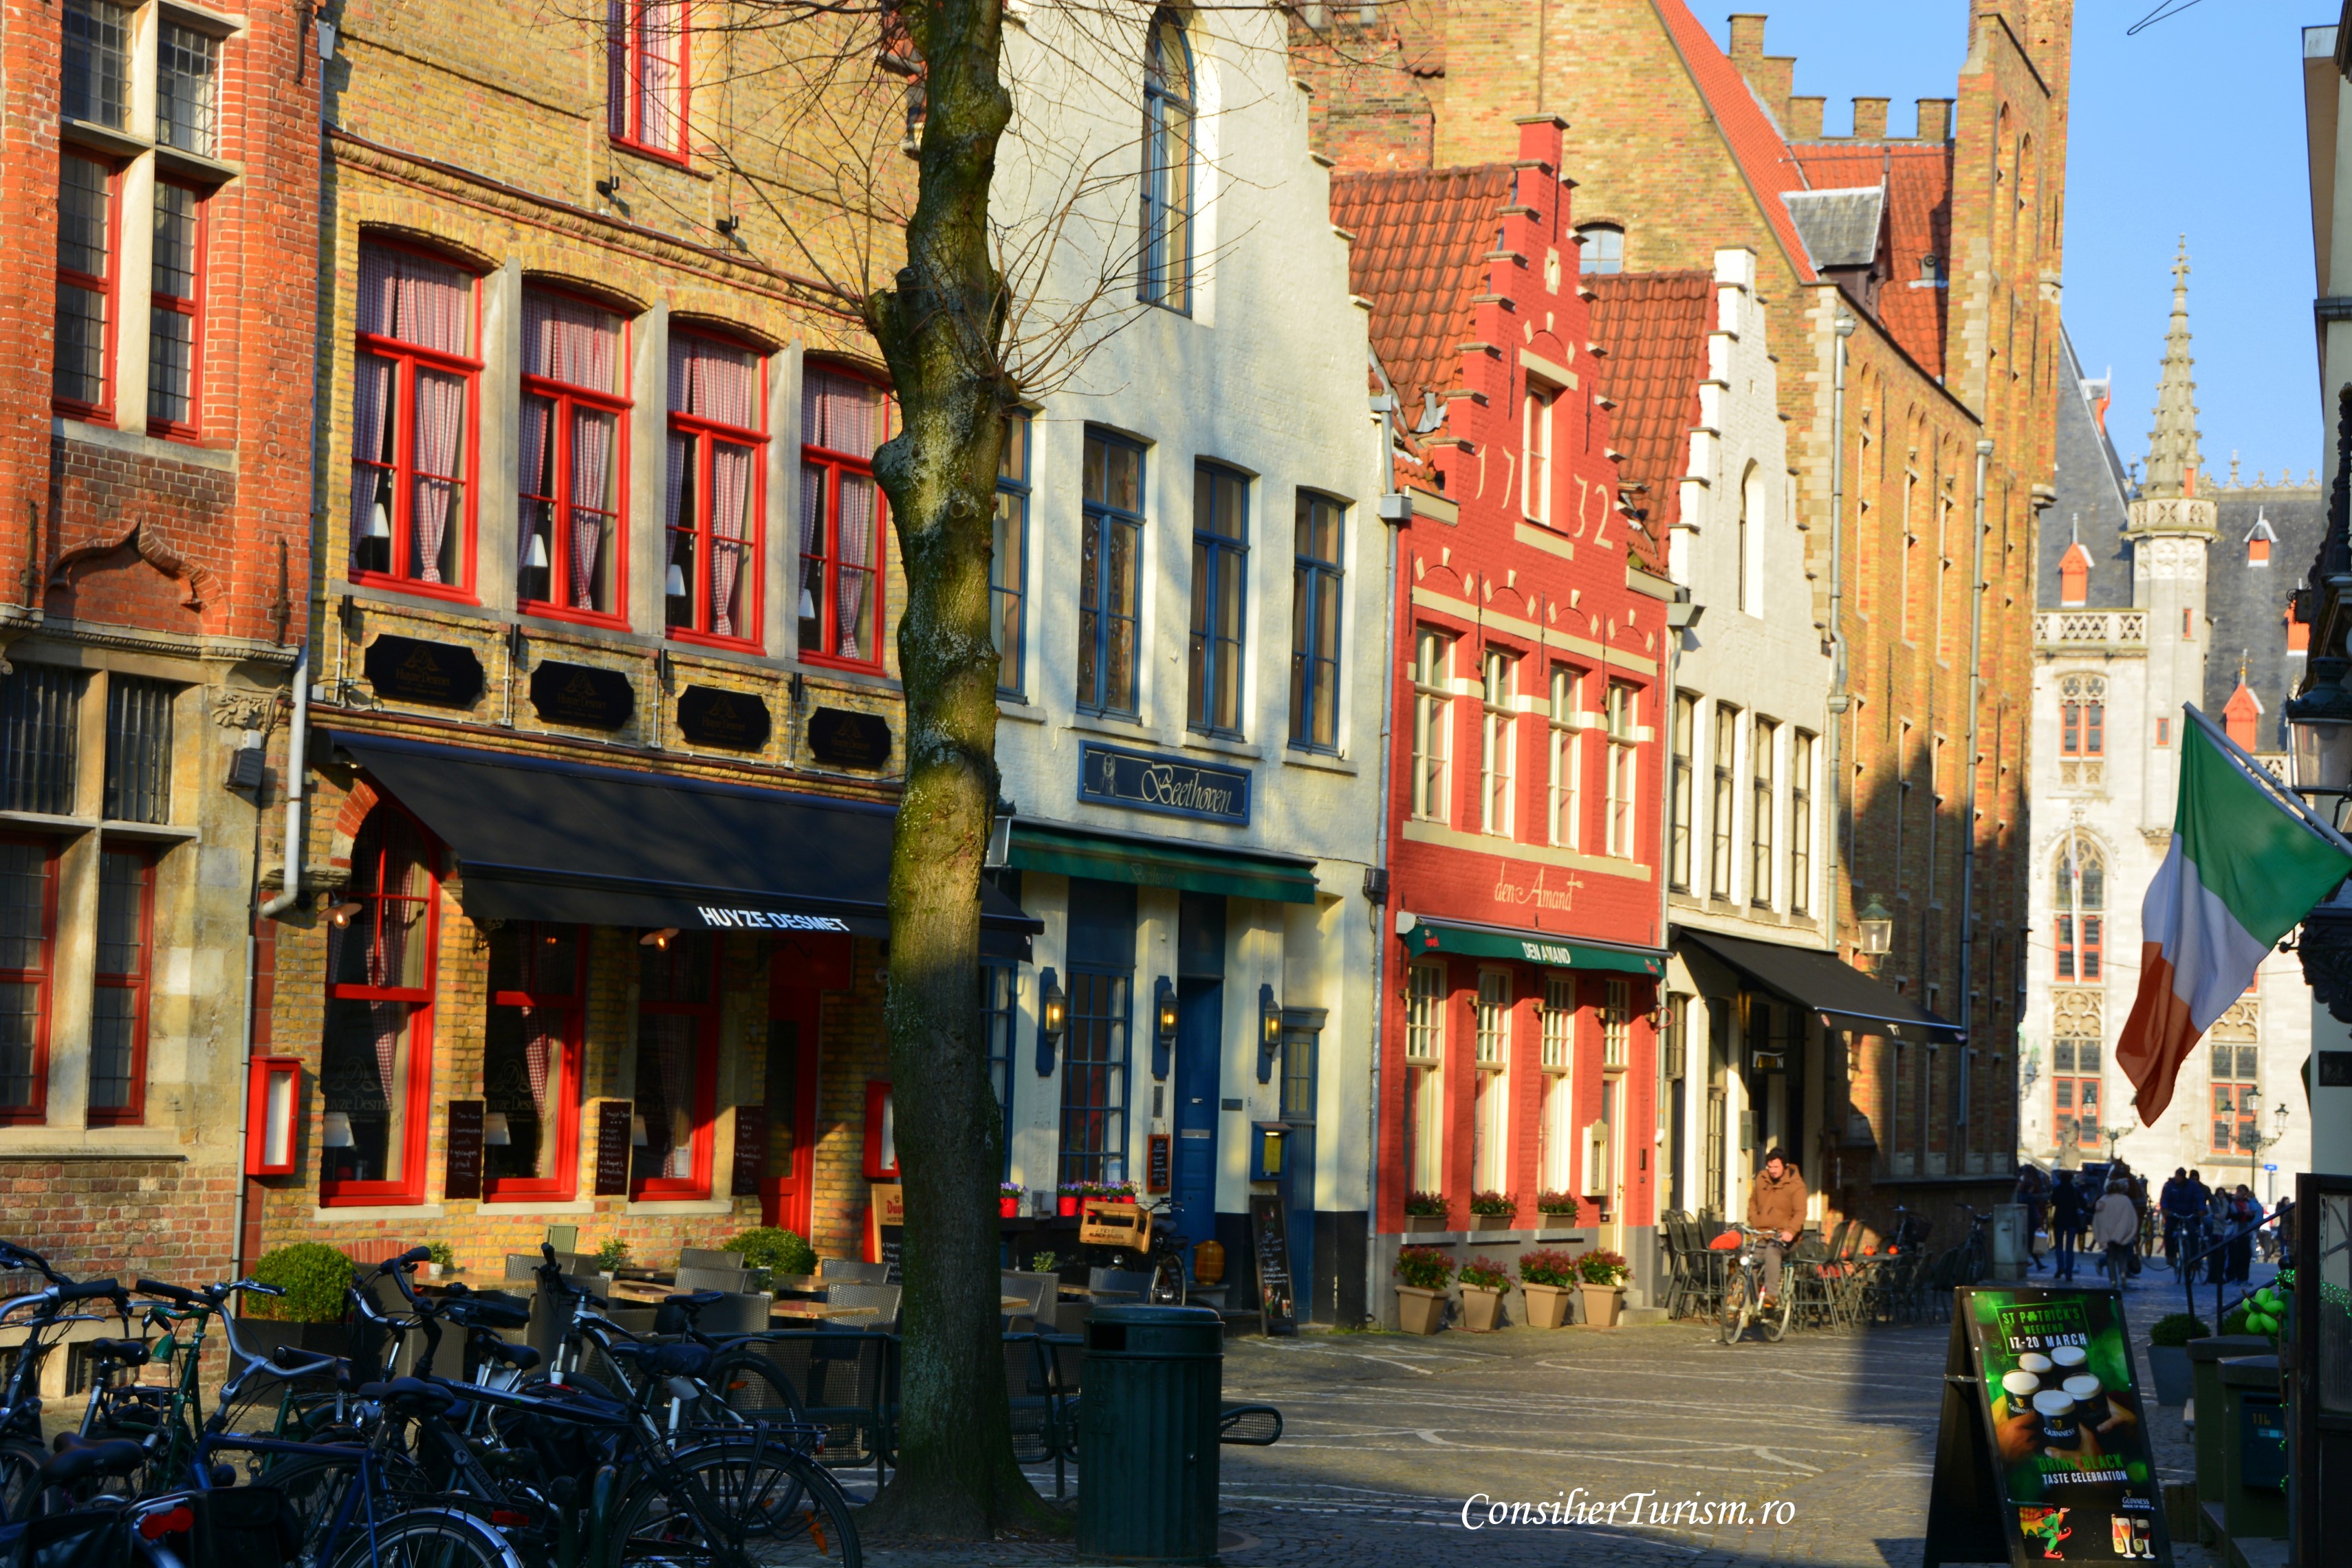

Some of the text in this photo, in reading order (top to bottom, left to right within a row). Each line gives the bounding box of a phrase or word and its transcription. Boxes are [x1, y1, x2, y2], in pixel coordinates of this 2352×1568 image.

[1475, 444, 1613, 550] 17 32
[1140, 760, 1232, 814] Beethoven
[1494, 860, 1573, 912] den Amand
[697, 906, 851, 932] HUYZE DESMET
[1521, 941, 1571, 964] DEN AMAND
[2002, 1307, 2080, 1325] ST PTRICK'S
[2023, 1322, 2065, 1335] WEEKEND
[2009, 1332, 2087, 1349] 17-20 MARCH
[2043, 1426, 2076, 1438] GUINNESS
[2038, 1453, 2124, 1472] DRINK BLACK
[2042, 1470, 2128, 1485] TASTE CELEBRATION
[2122, 1496, 2150, 1505] GUINNESS
